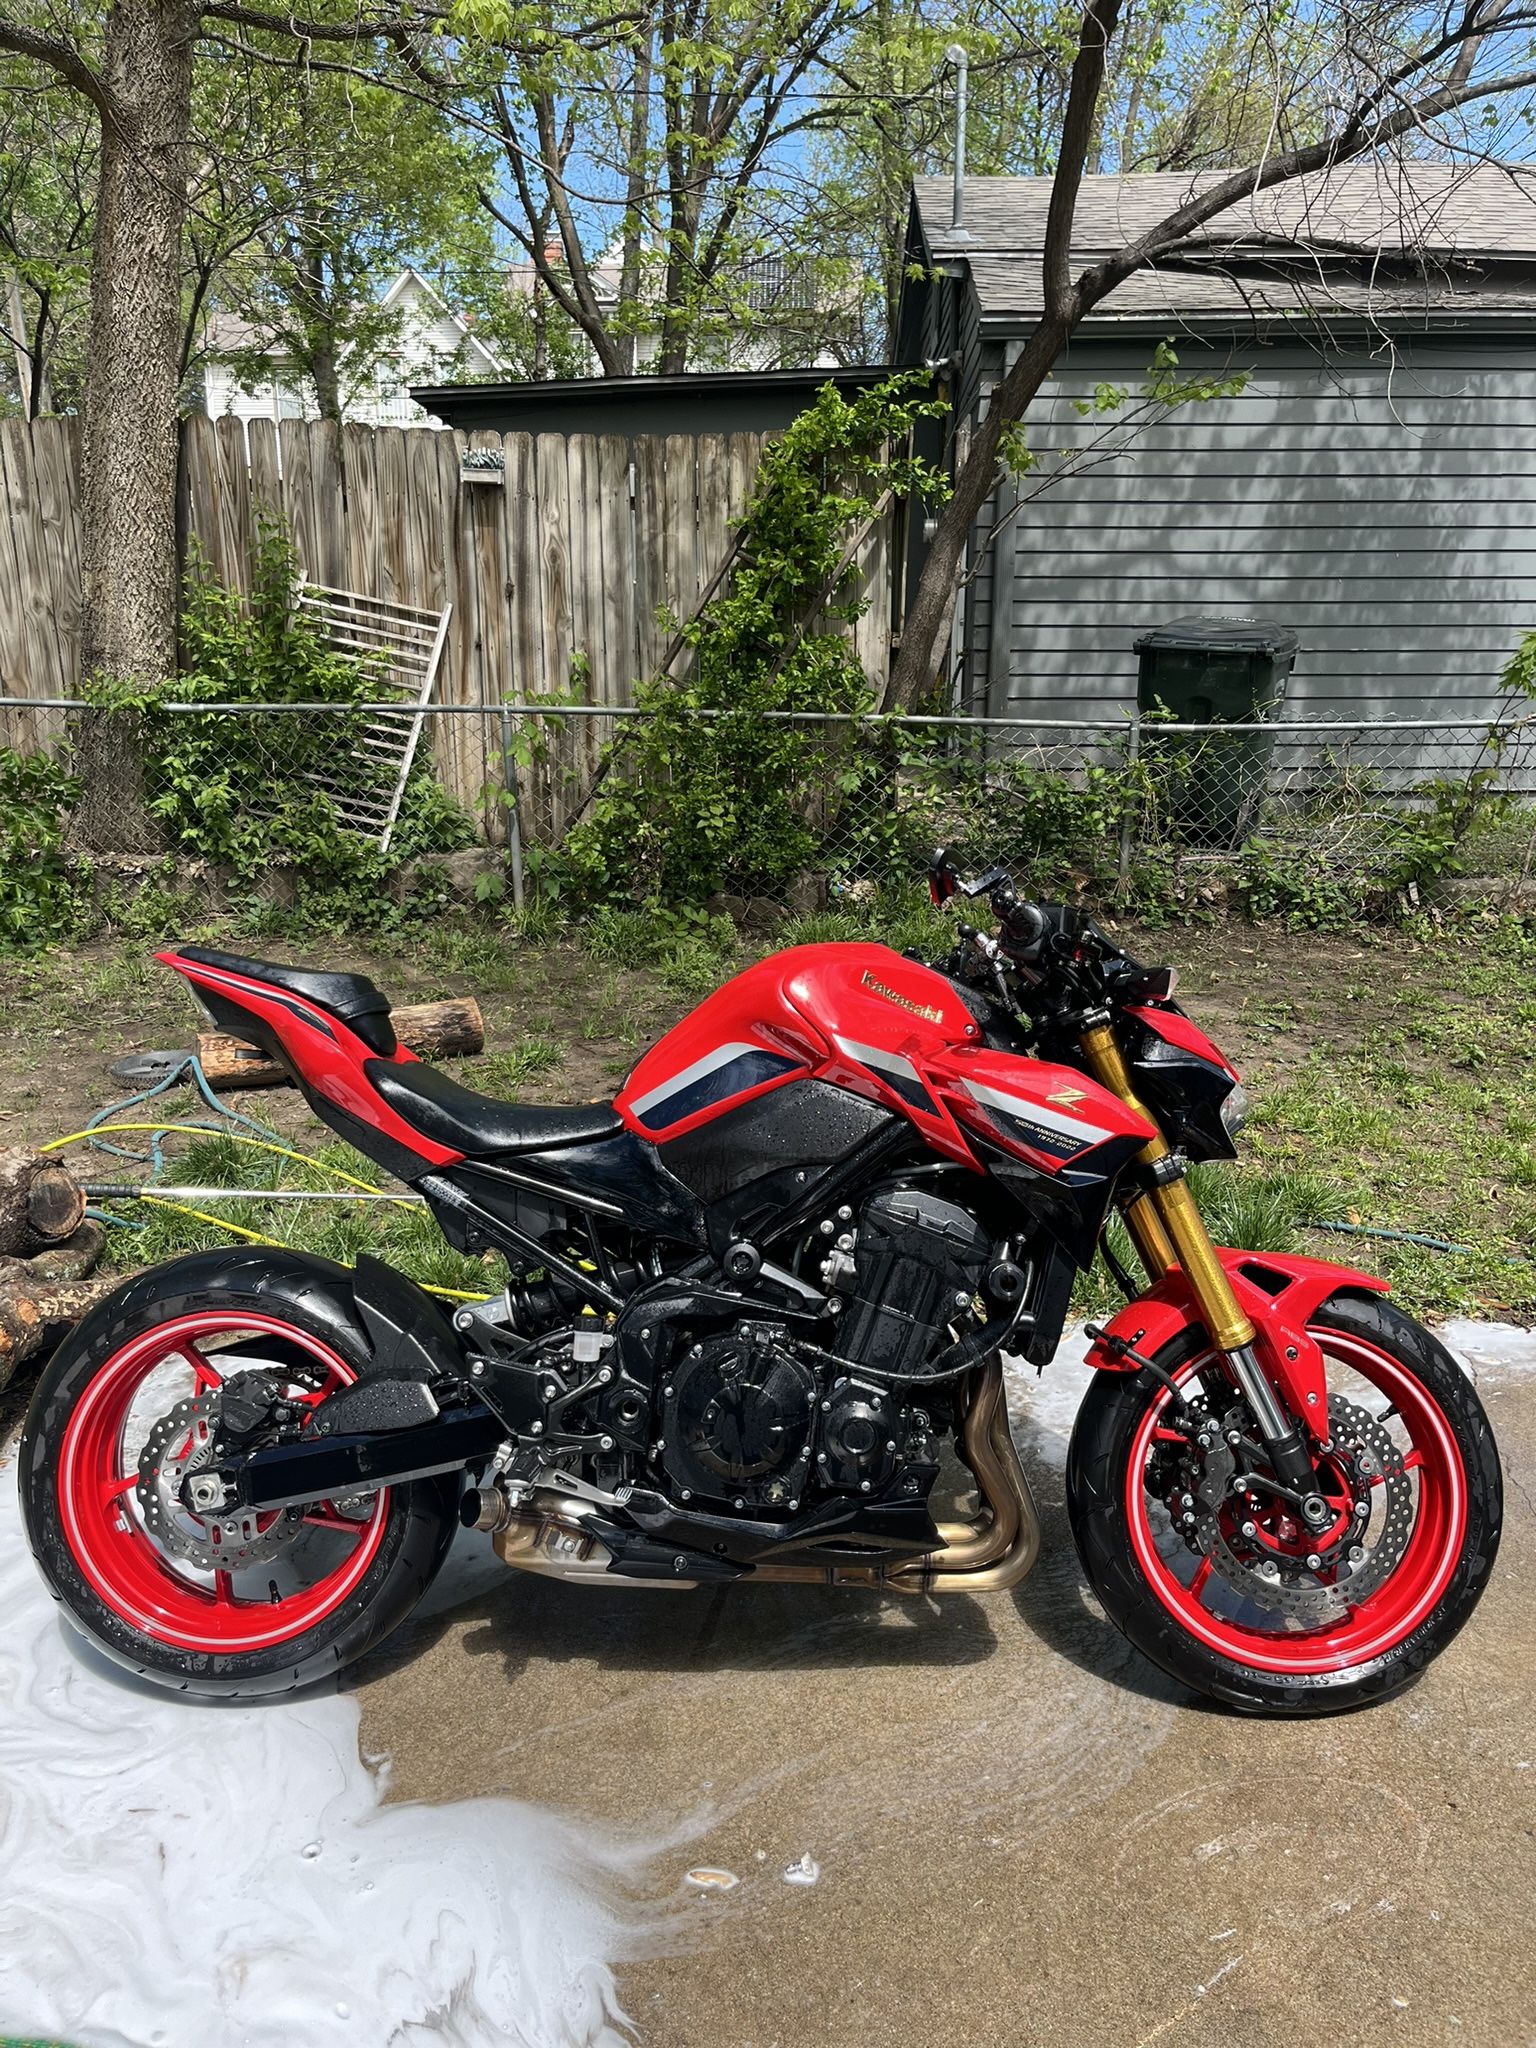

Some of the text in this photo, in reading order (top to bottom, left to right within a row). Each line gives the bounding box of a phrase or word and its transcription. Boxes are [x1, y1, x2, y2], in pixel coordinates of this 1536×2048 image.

[861, 970, 943, 1024] Kawasaki
[1034, 1127, 1082, 1146] ANNIVERSARY
[1037, 1134, 1076, 1151] 1972-2022
